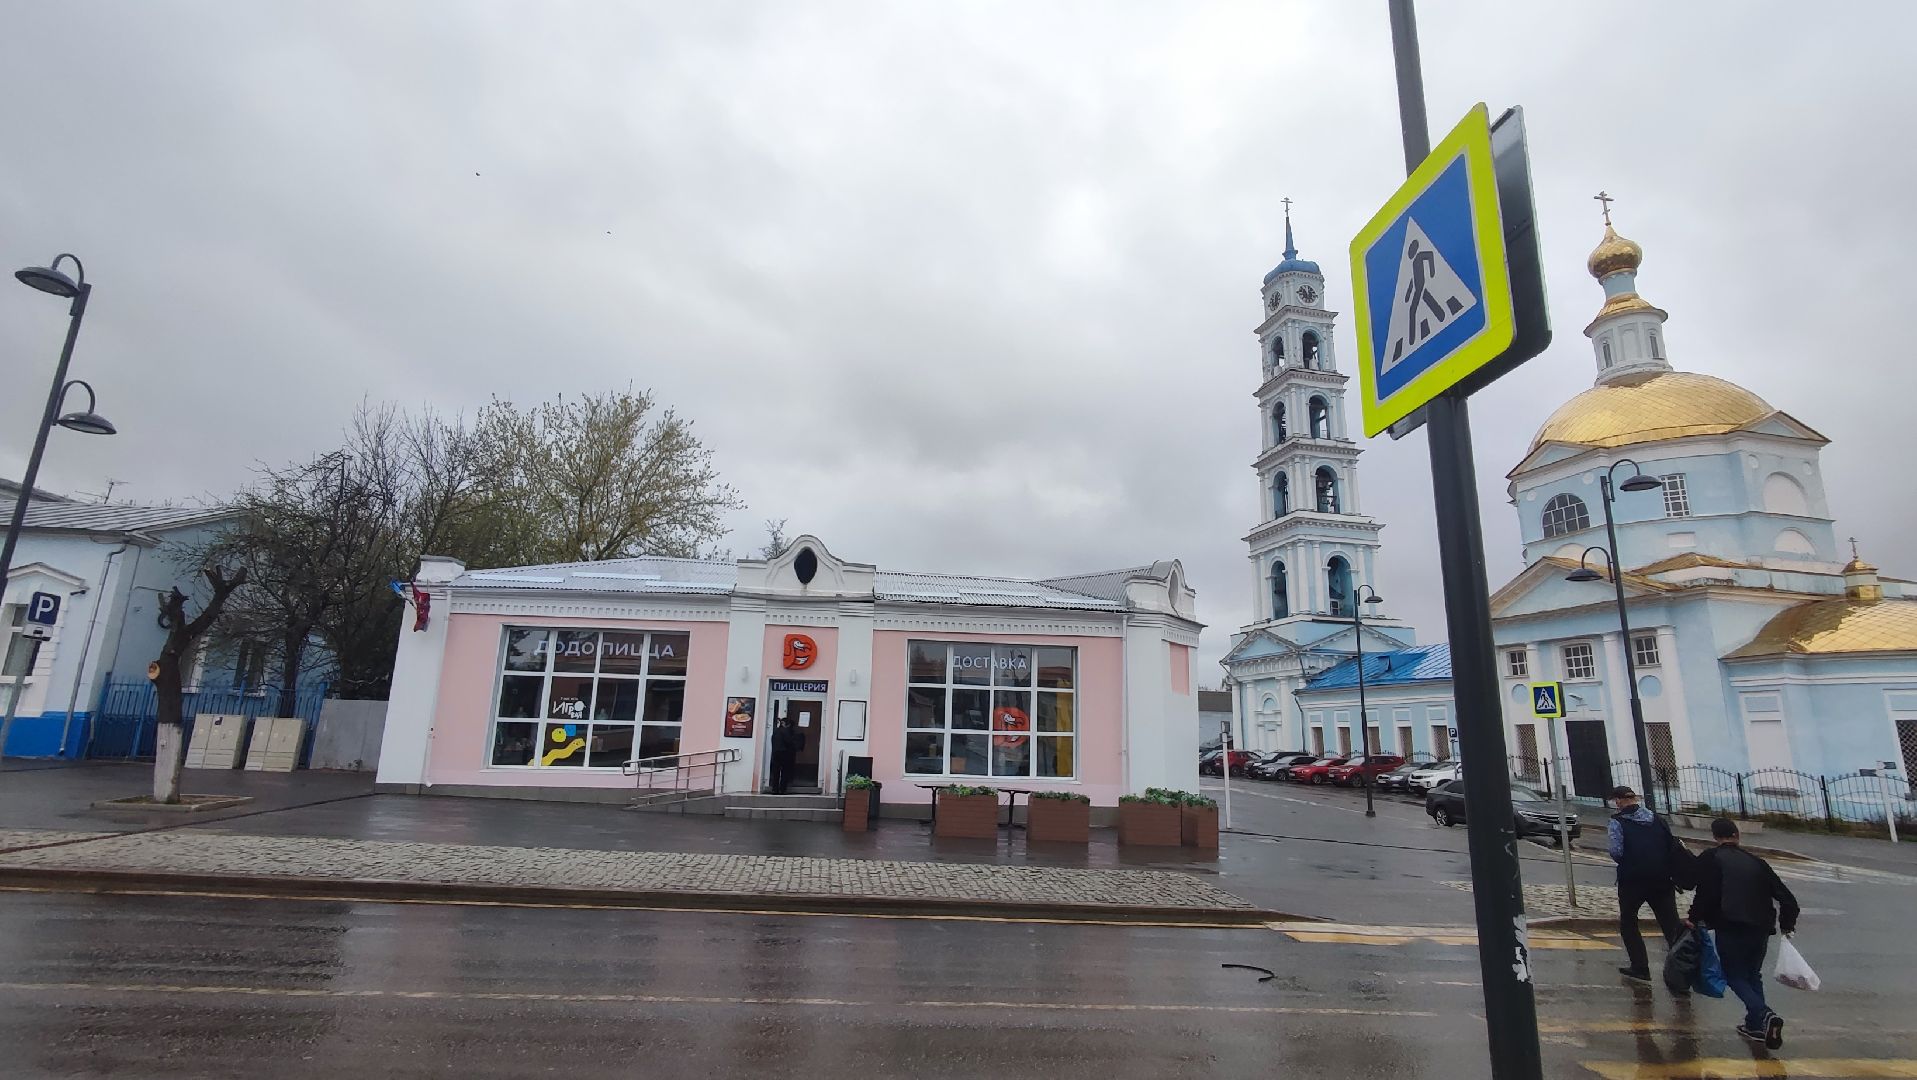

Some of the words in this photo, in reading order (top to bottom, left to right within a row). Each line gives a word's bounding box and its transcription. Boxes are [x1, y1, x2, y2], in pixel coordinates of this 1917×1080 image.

[35, 596, 54, 620] P
[534, 641, 594, 656] ДОДО
[602, 642, 674, 659] ПИЦЦА
[773, 682, 827, 692] ПИЦЦЕРИЯ
[1449, 728, 1456, 737] P
